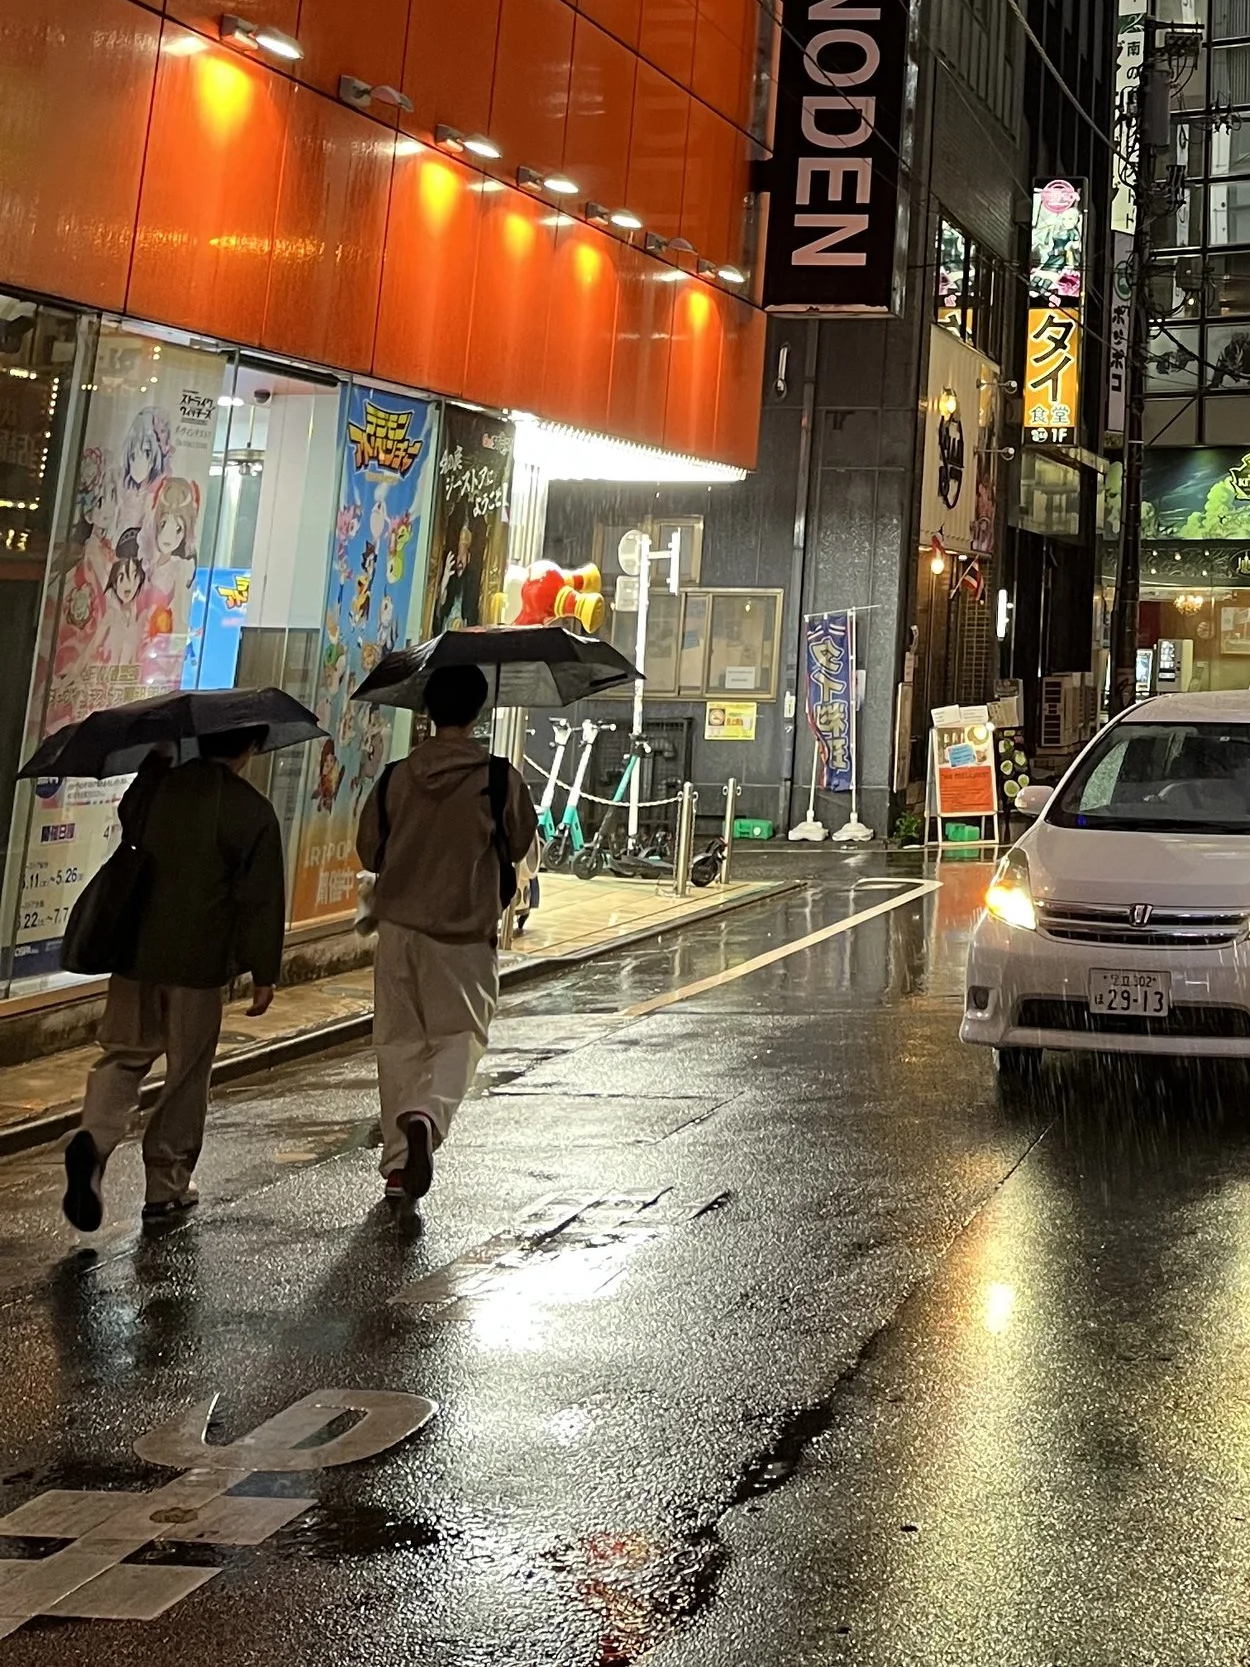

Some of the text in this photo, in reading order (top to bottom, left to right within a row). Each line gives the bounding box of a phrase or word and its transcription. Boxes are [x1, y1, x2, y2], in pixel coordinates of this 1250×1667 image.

[1031, 314, 1075, 402] タイ
[1030, 406, 1070, 425] 食堂
[1107, 989, 1164, 1012] 29-13
